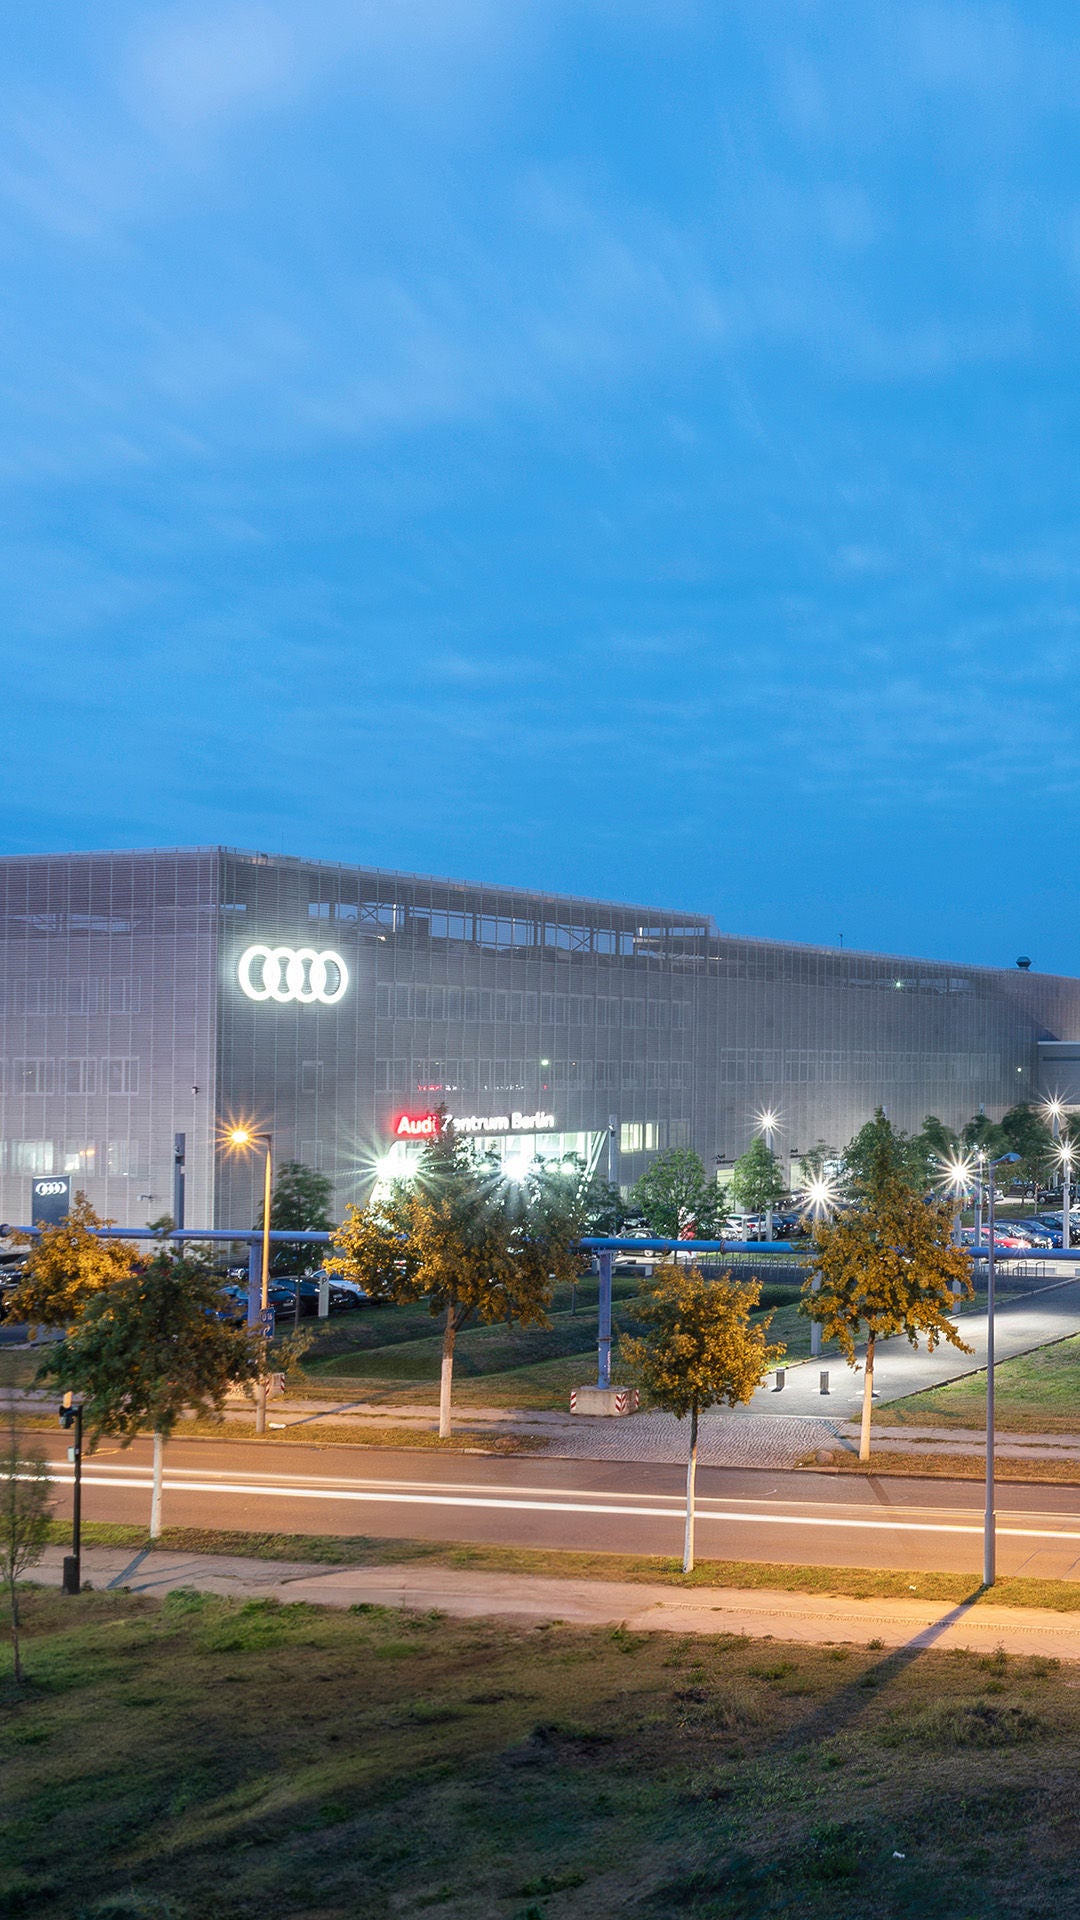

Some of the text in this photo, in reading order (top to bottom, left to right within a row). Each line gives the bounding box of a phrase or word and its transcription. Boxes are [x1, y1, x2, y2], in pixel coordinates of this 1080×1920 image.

[397, 1111, 554, 1134] Audi Zentrum Berlin
